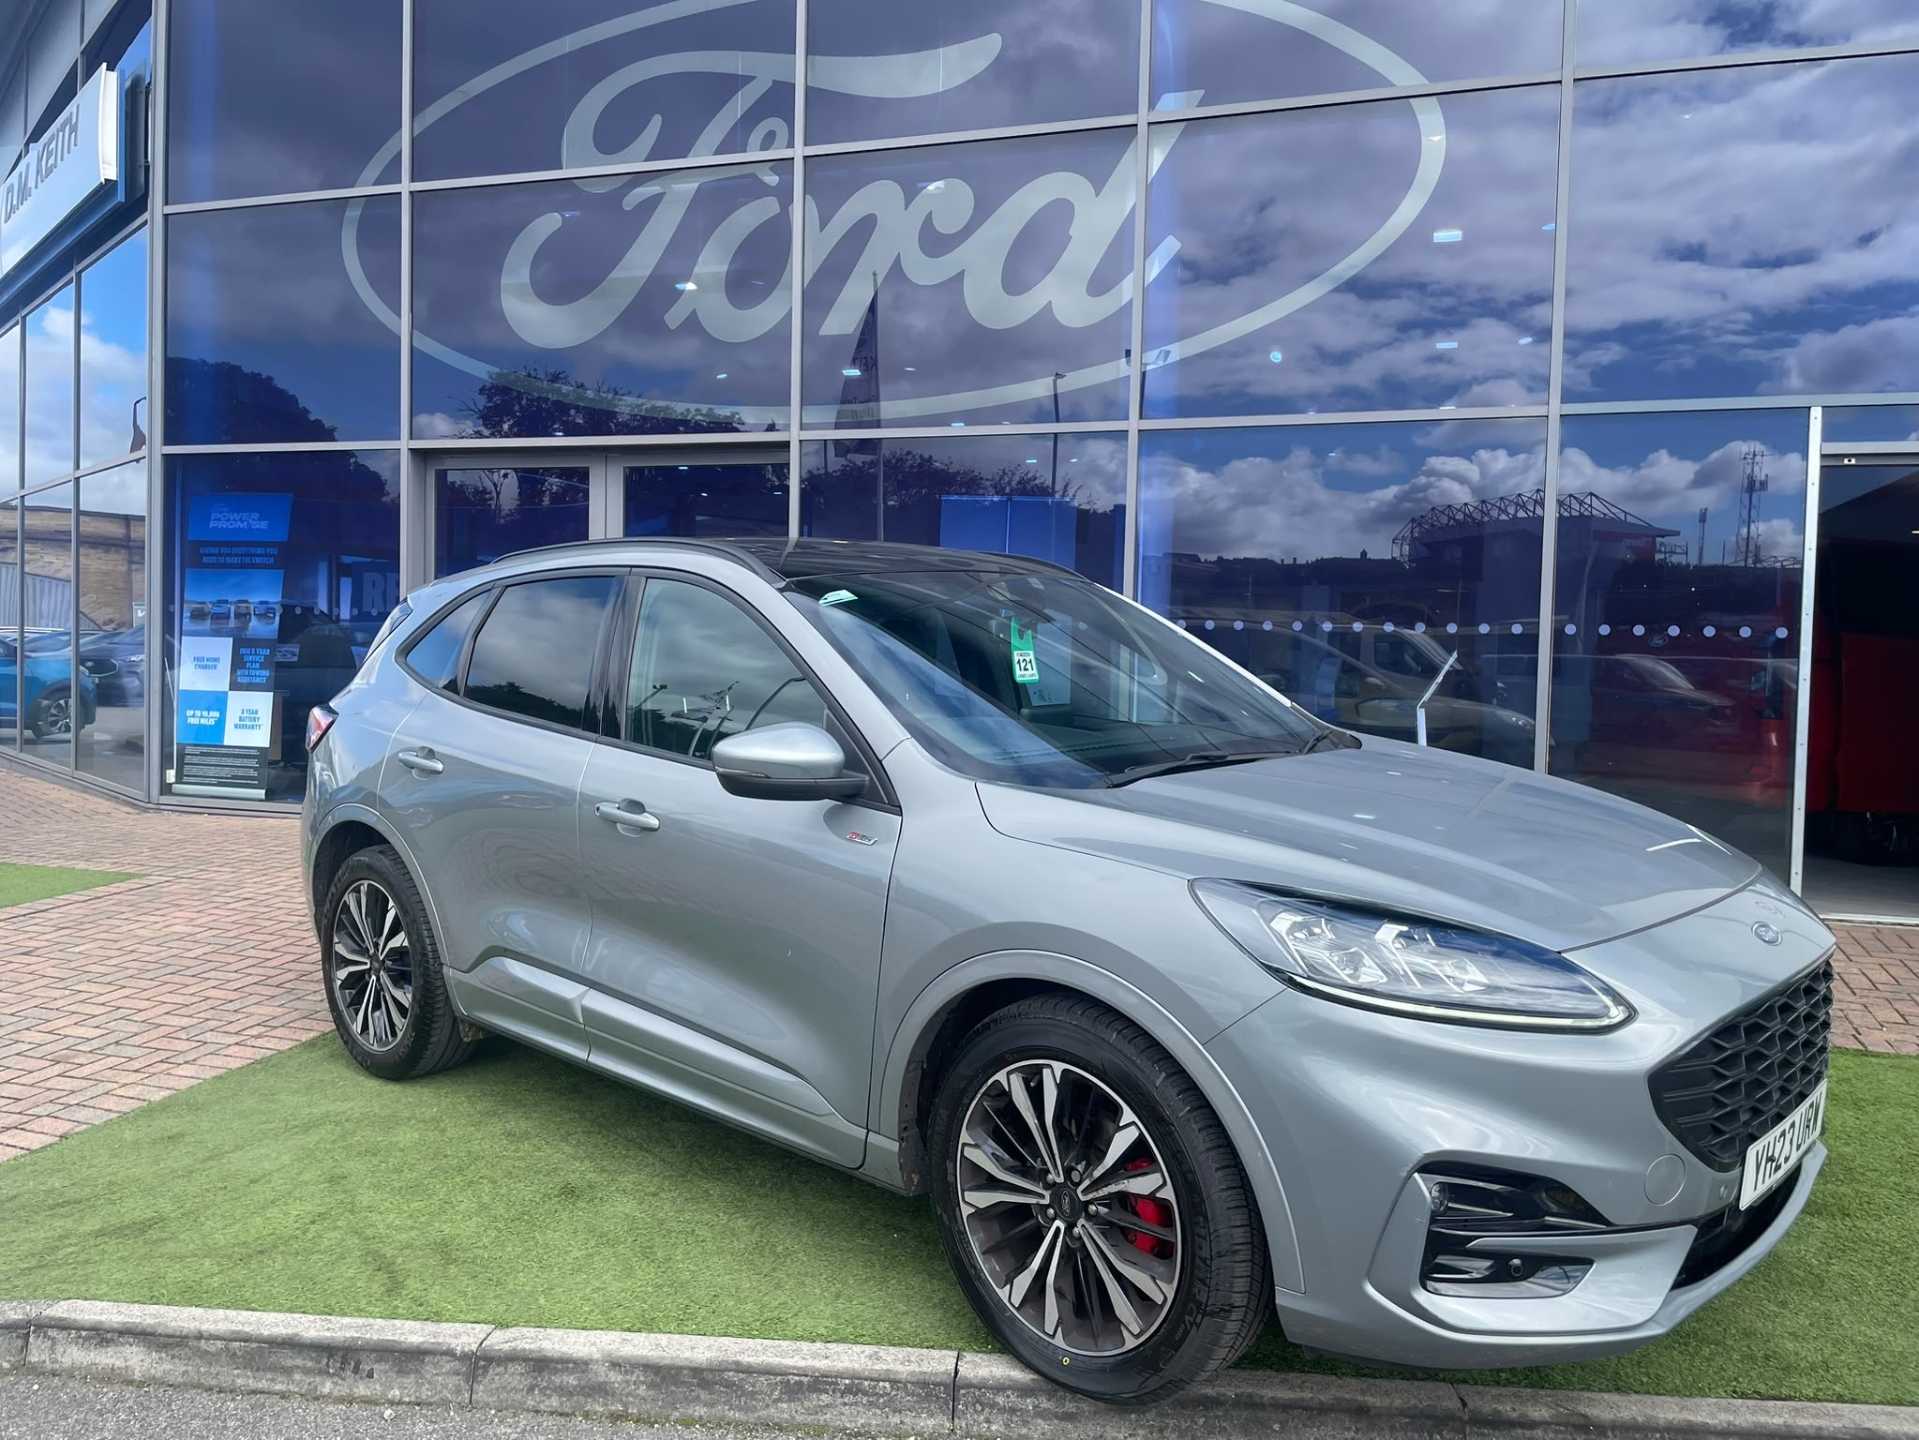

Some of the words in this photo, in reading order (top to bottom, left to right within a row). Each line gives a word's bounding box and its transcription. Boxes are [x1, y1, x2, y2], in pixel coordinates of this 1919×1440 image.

[4, 161, 32, 224] D.M.
[34, 103, 80, 190] KEITH
[500, 32, 1205, 350] Ford
[209, 520, 269, 529] PROMISE
[210, 512, 261, 520] POWER
[1016, 658, 1034, 672] 121
[1753, 1119, 1796, 1192] YH23
